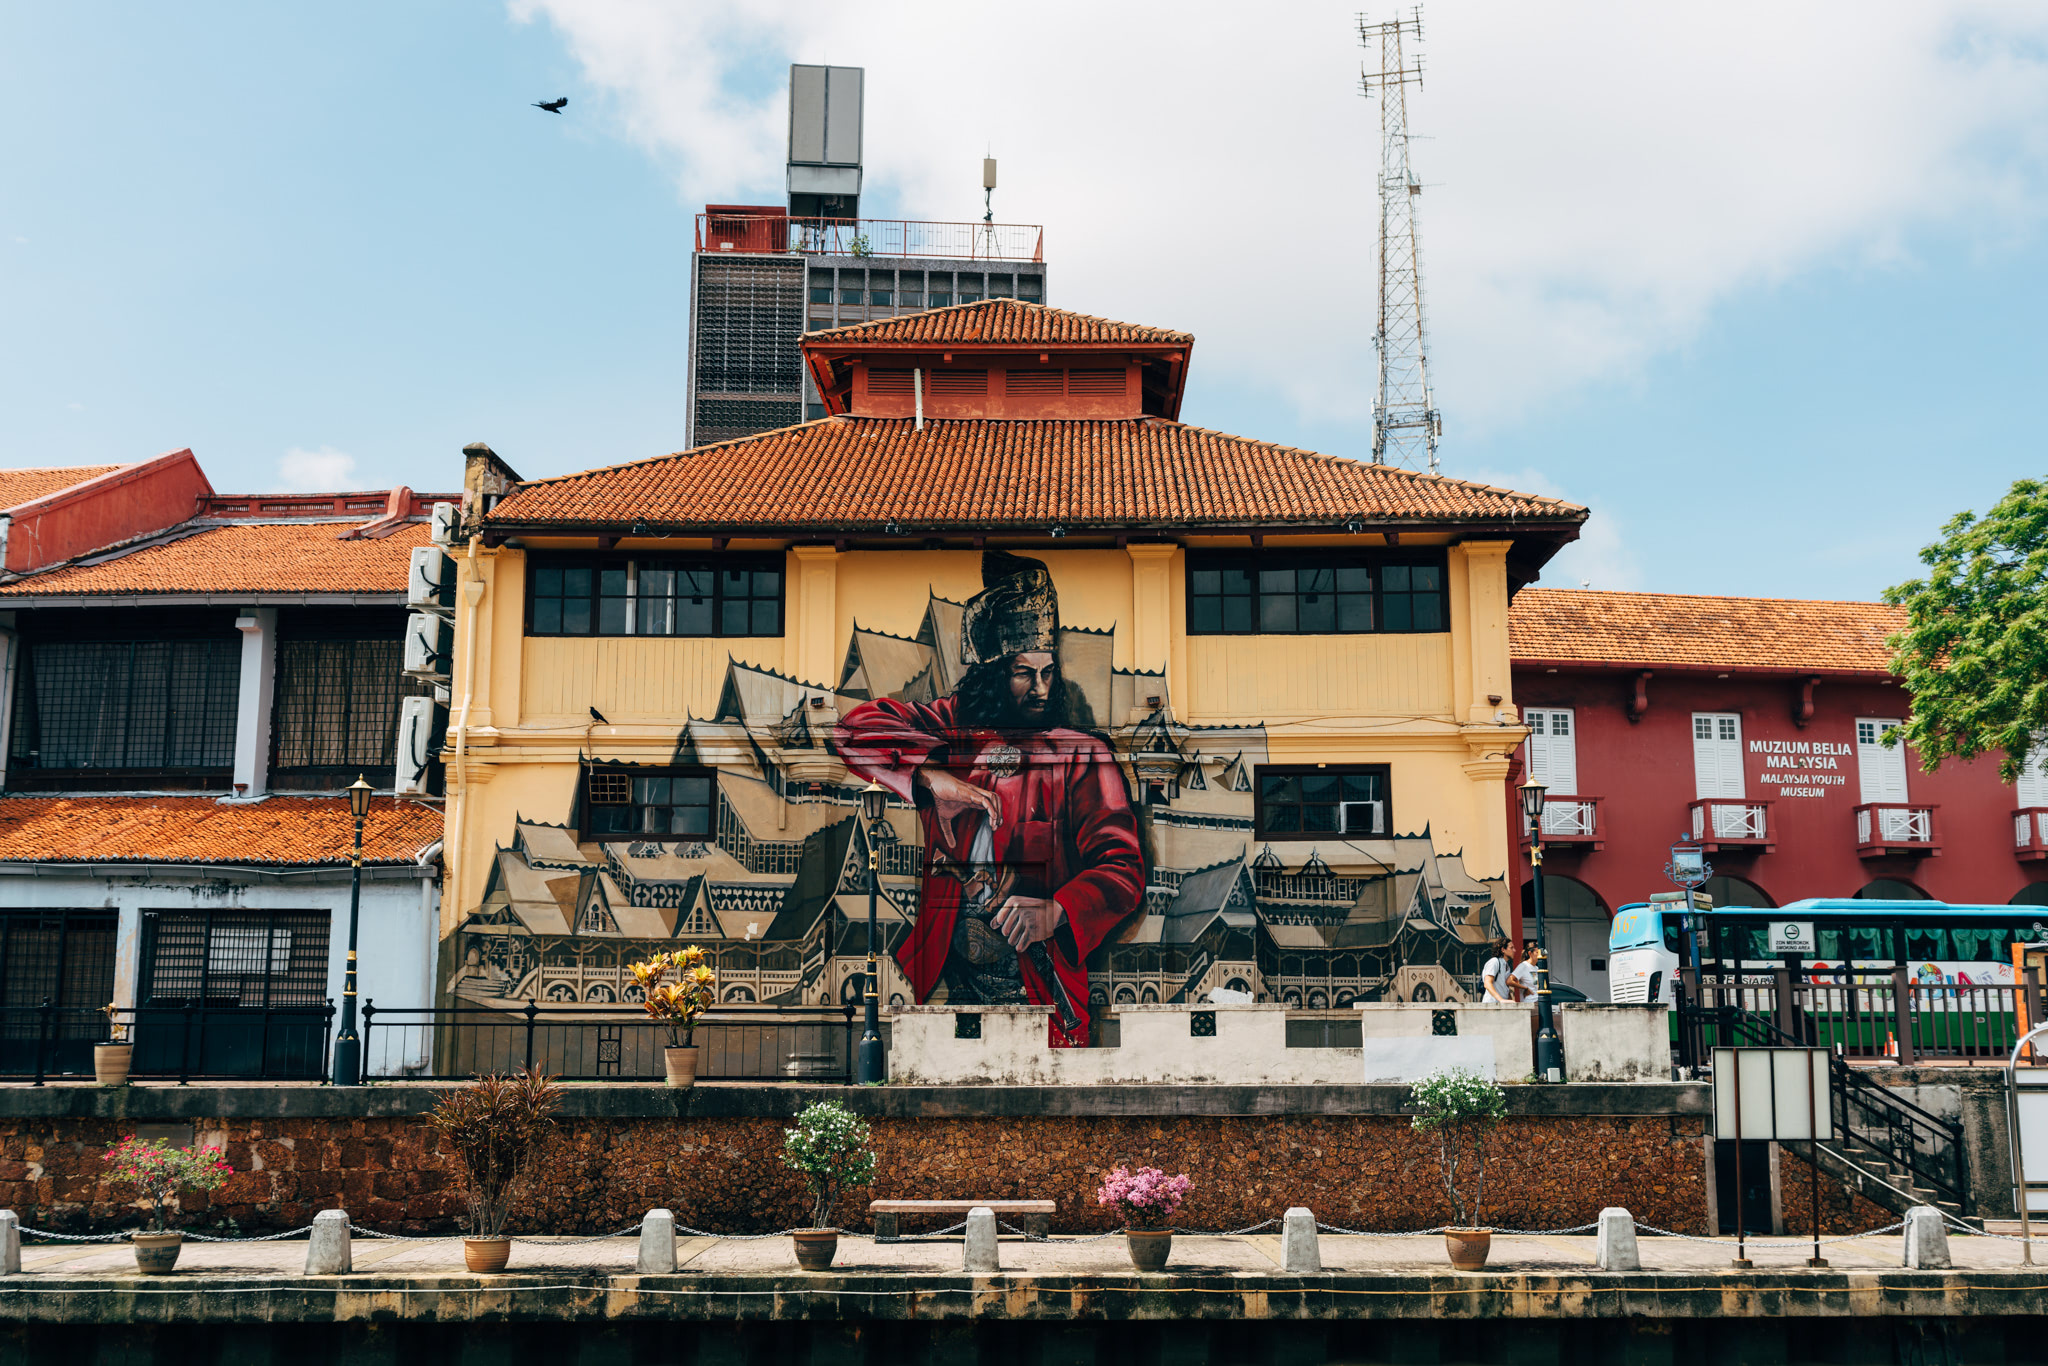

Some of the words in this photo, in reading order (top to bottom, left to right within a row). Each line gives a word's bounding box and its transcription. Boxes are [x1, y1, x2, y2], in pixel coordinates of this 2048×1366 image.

[1750, 741, 1809, 754] MUZIUM
[1813, 742, 1852, 755] BELIA
[1766, 756, 1837, 769] MALAYSIA
[1761, 774, 1809, 784] MALAYSIA
[1812, 775, 1845, 785] YOUTH
[1781, 787, 1824, 797] MUSEUM
